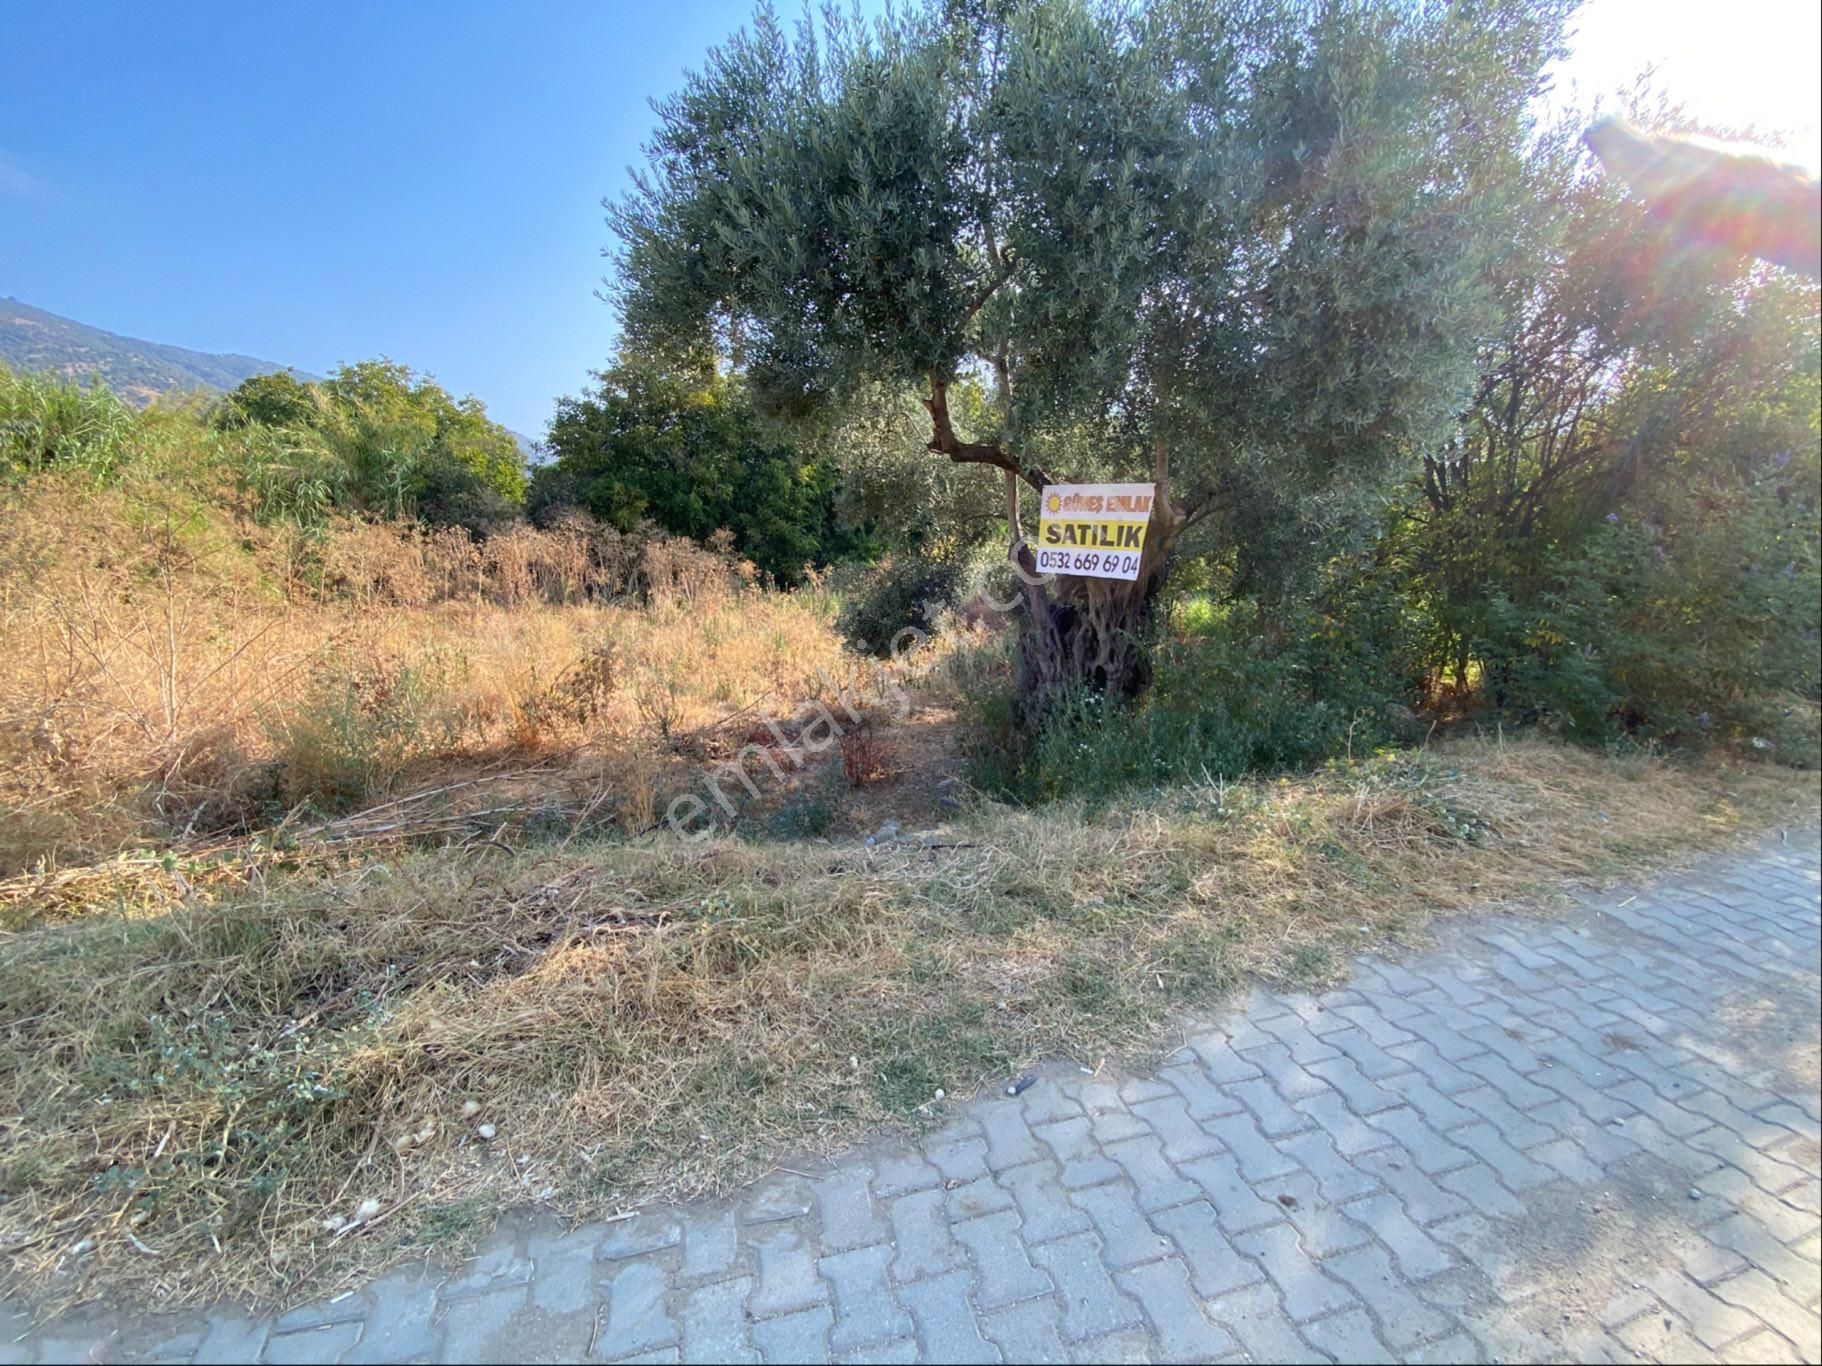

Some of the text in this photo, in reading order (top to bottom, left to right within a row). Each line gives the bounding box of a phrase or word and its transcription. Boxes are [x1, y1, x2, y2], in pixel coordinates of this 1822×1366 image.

[1106, 495, 1152, 513] EMLAK
[1045, 523, 1144, 548] SATILIK
[1040, 551, 1139, 575] 0532 669 69 04
